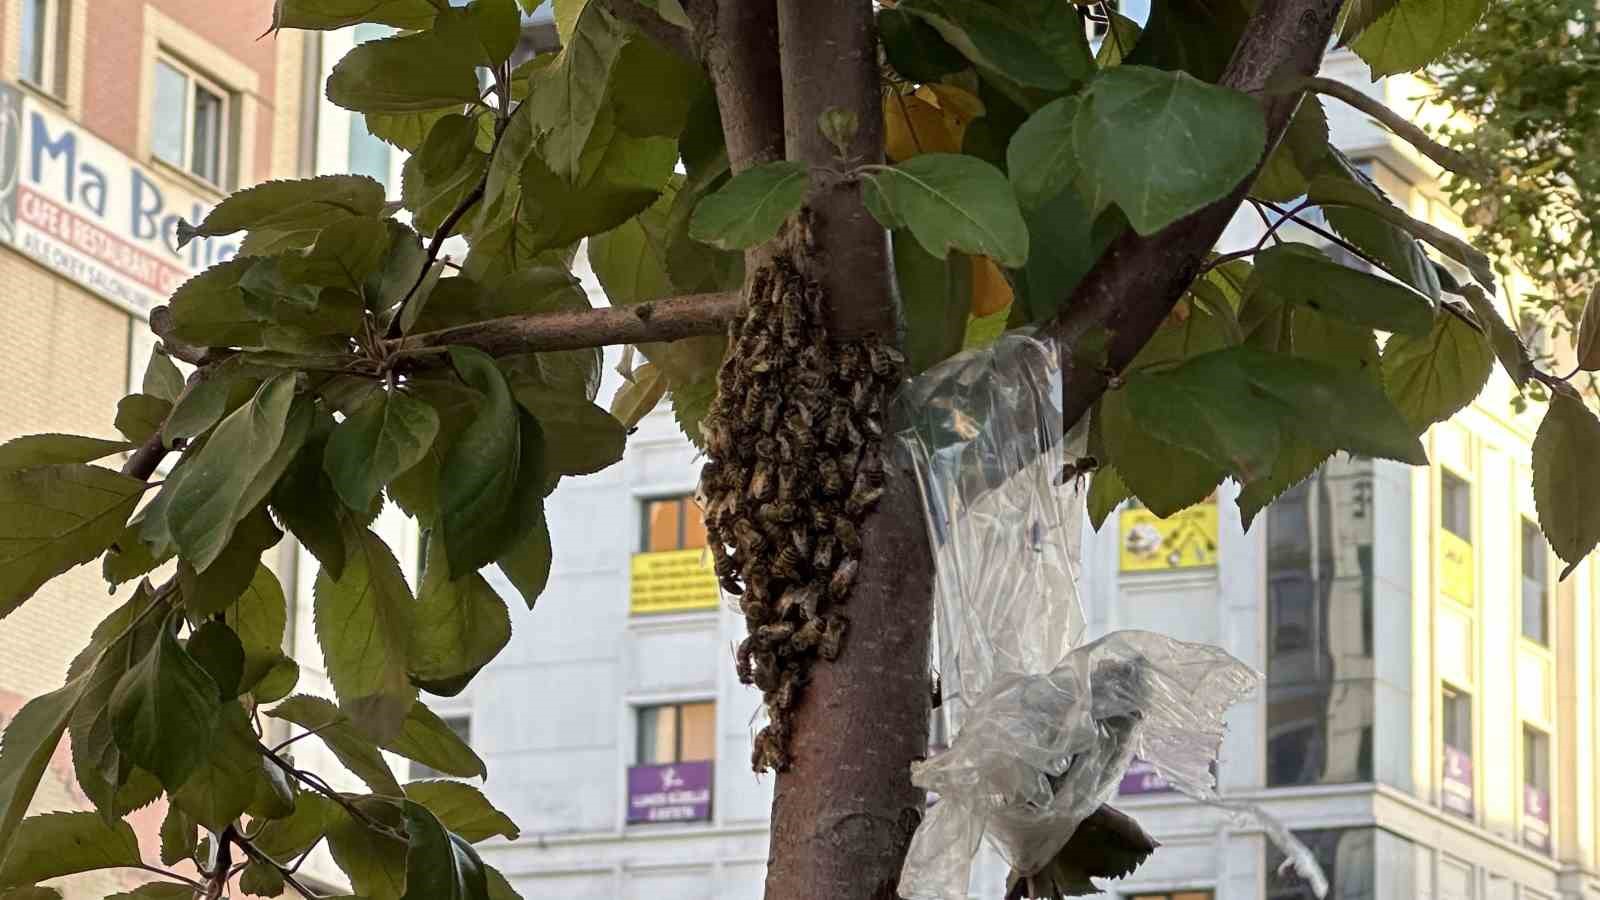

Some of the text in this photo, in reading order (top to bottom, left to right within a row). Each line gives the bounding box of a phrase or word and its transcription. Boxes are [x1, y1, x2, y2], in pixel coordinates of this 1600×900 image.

[31, 112, 107, 217] Ma
[21, 192, 60, 229] CAFE
[73, 218, 157, 288] RESTAURANT
